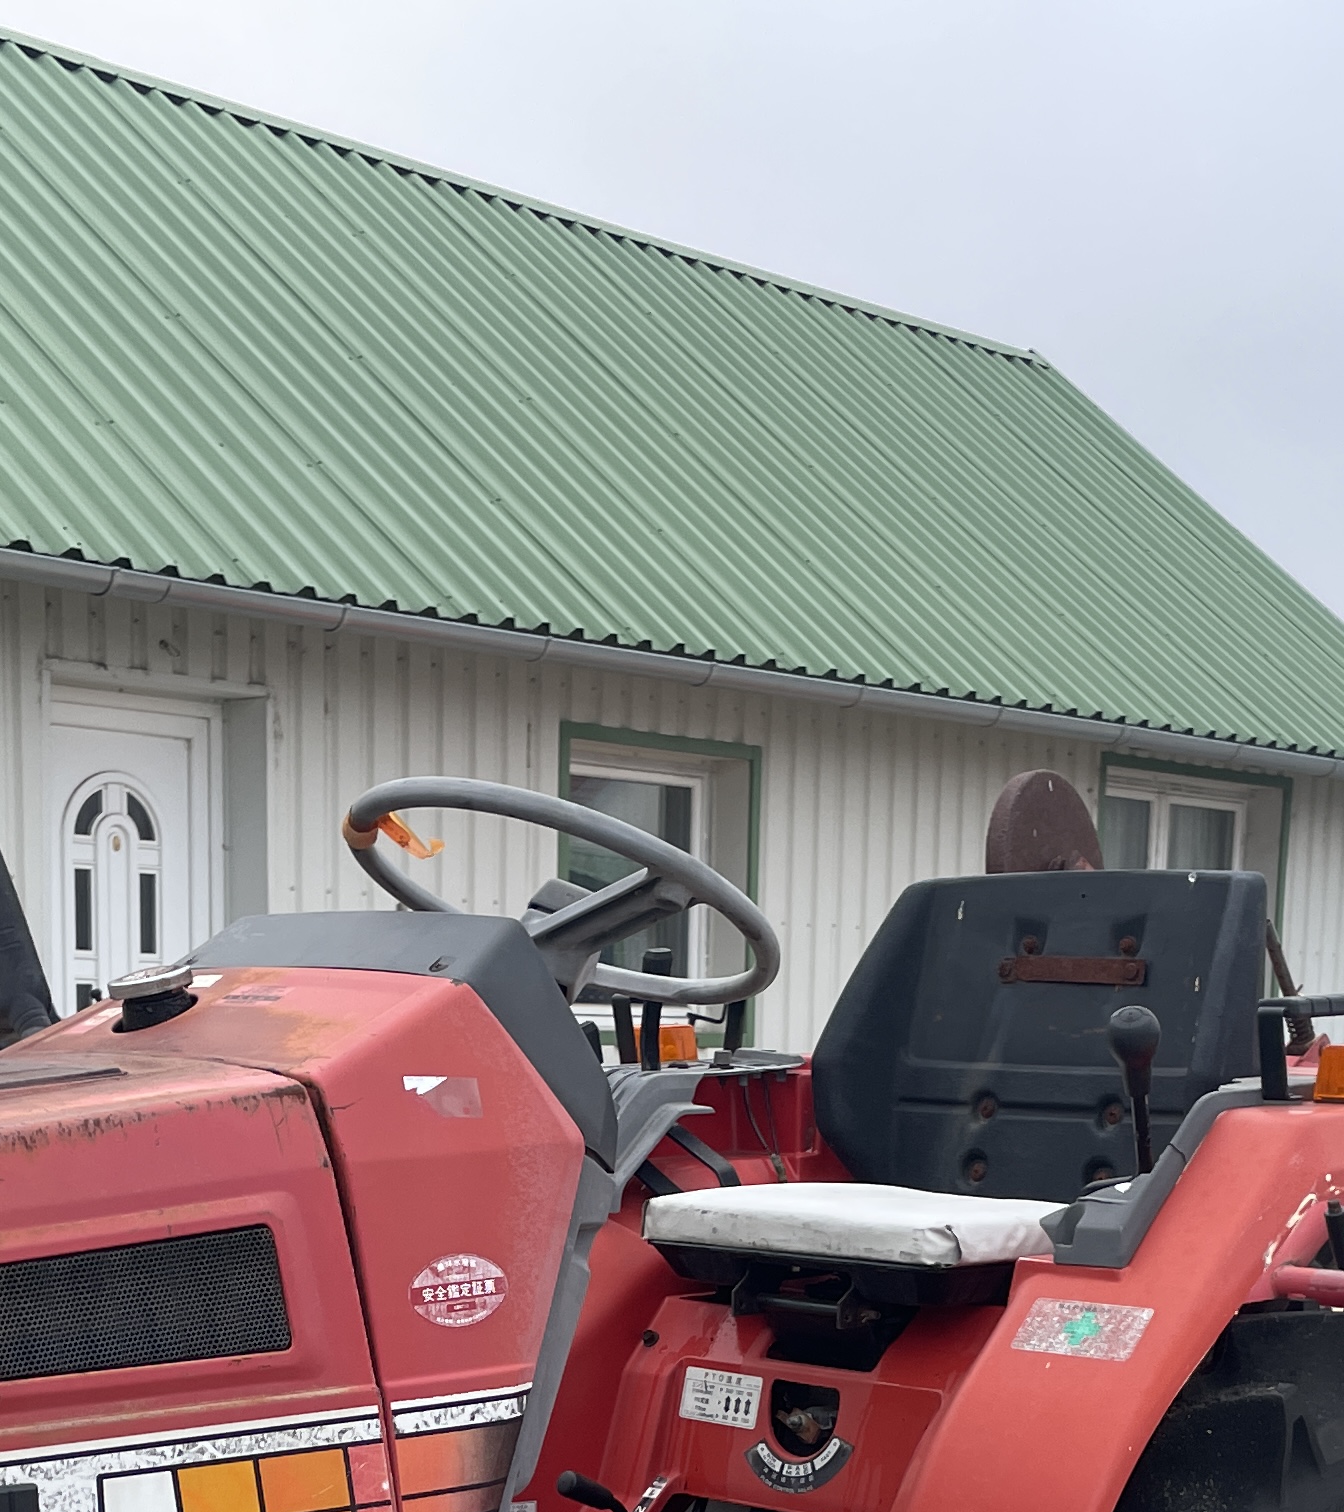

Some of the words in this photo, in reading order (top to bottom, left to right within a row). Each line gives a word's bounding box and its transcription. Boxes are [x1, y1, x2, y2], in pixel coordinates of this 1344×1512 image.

[422, 1278, 497, 1303] 安全鑑定証票
